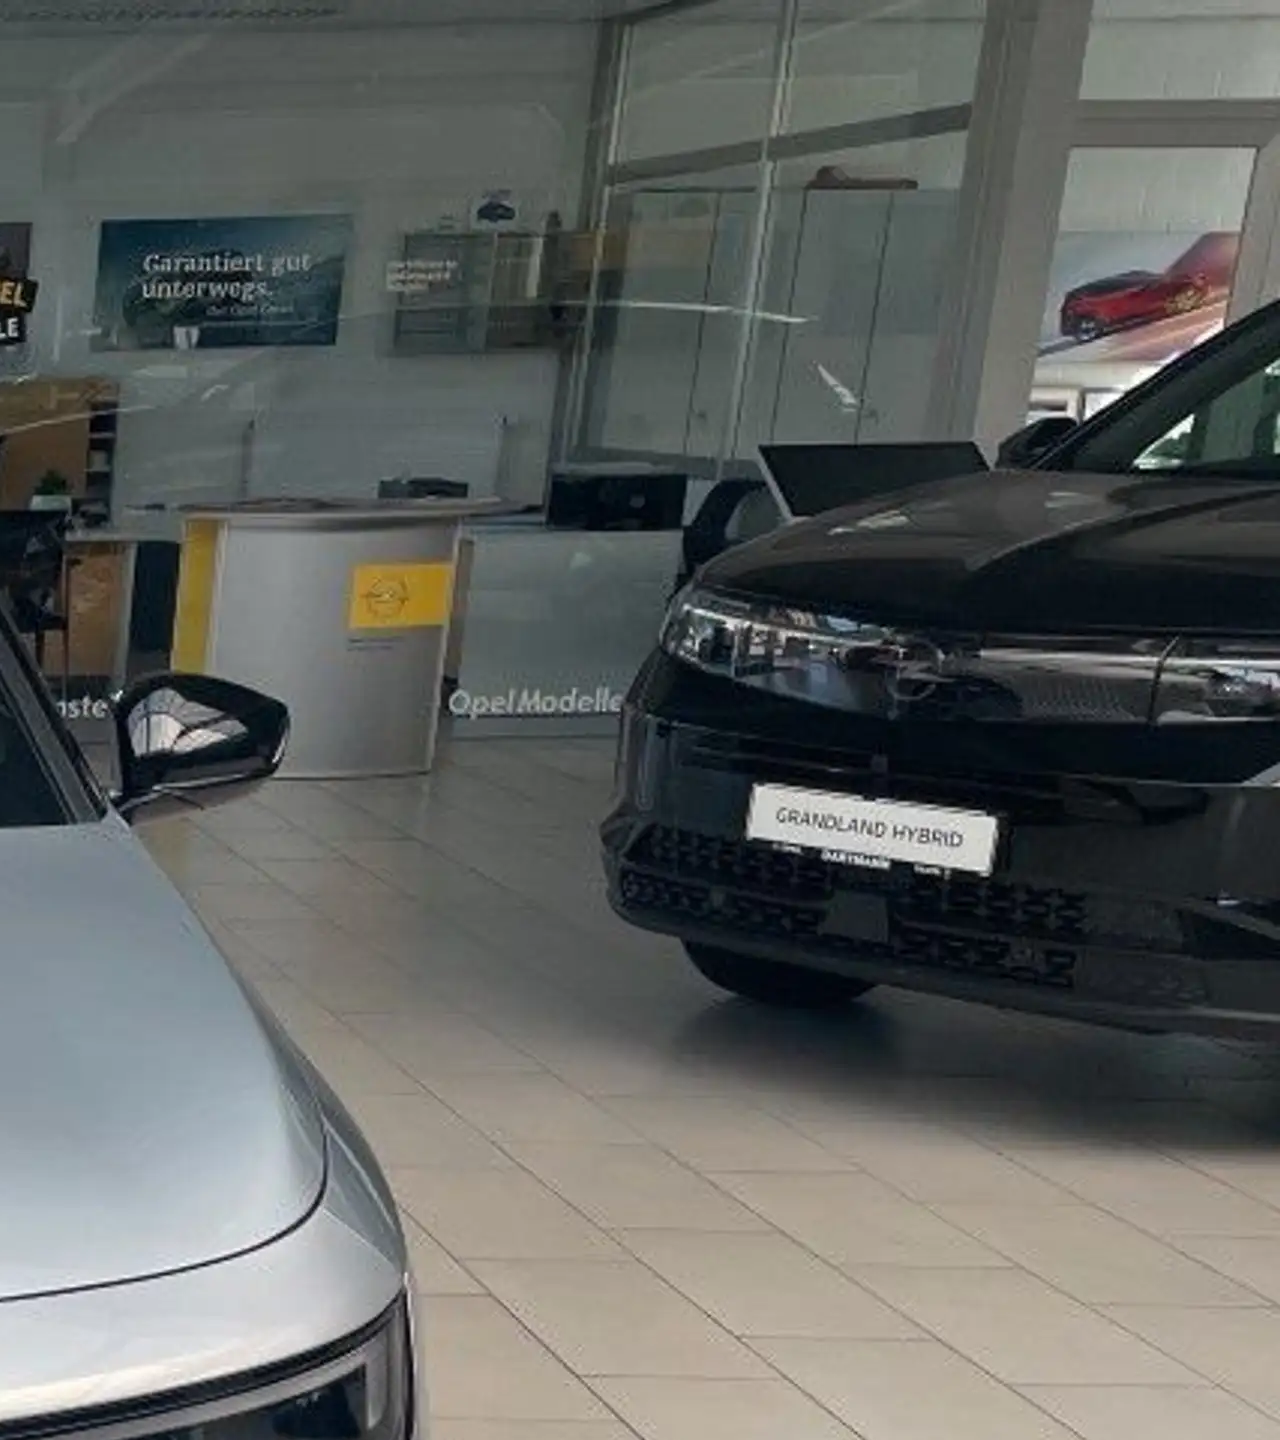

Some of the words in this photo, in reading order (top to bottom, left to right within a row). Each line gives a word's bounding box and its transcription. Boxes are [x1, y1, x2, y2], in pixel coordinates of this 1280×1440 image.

[142, 251, 264, 273] Garantiert
[271, 252, 313, 278] gut
[141, 279, 274, 303] unterwegs.
[775, 806, 887, 839] GRANDLAND
[891, 821, 964, 848] HYBRID
